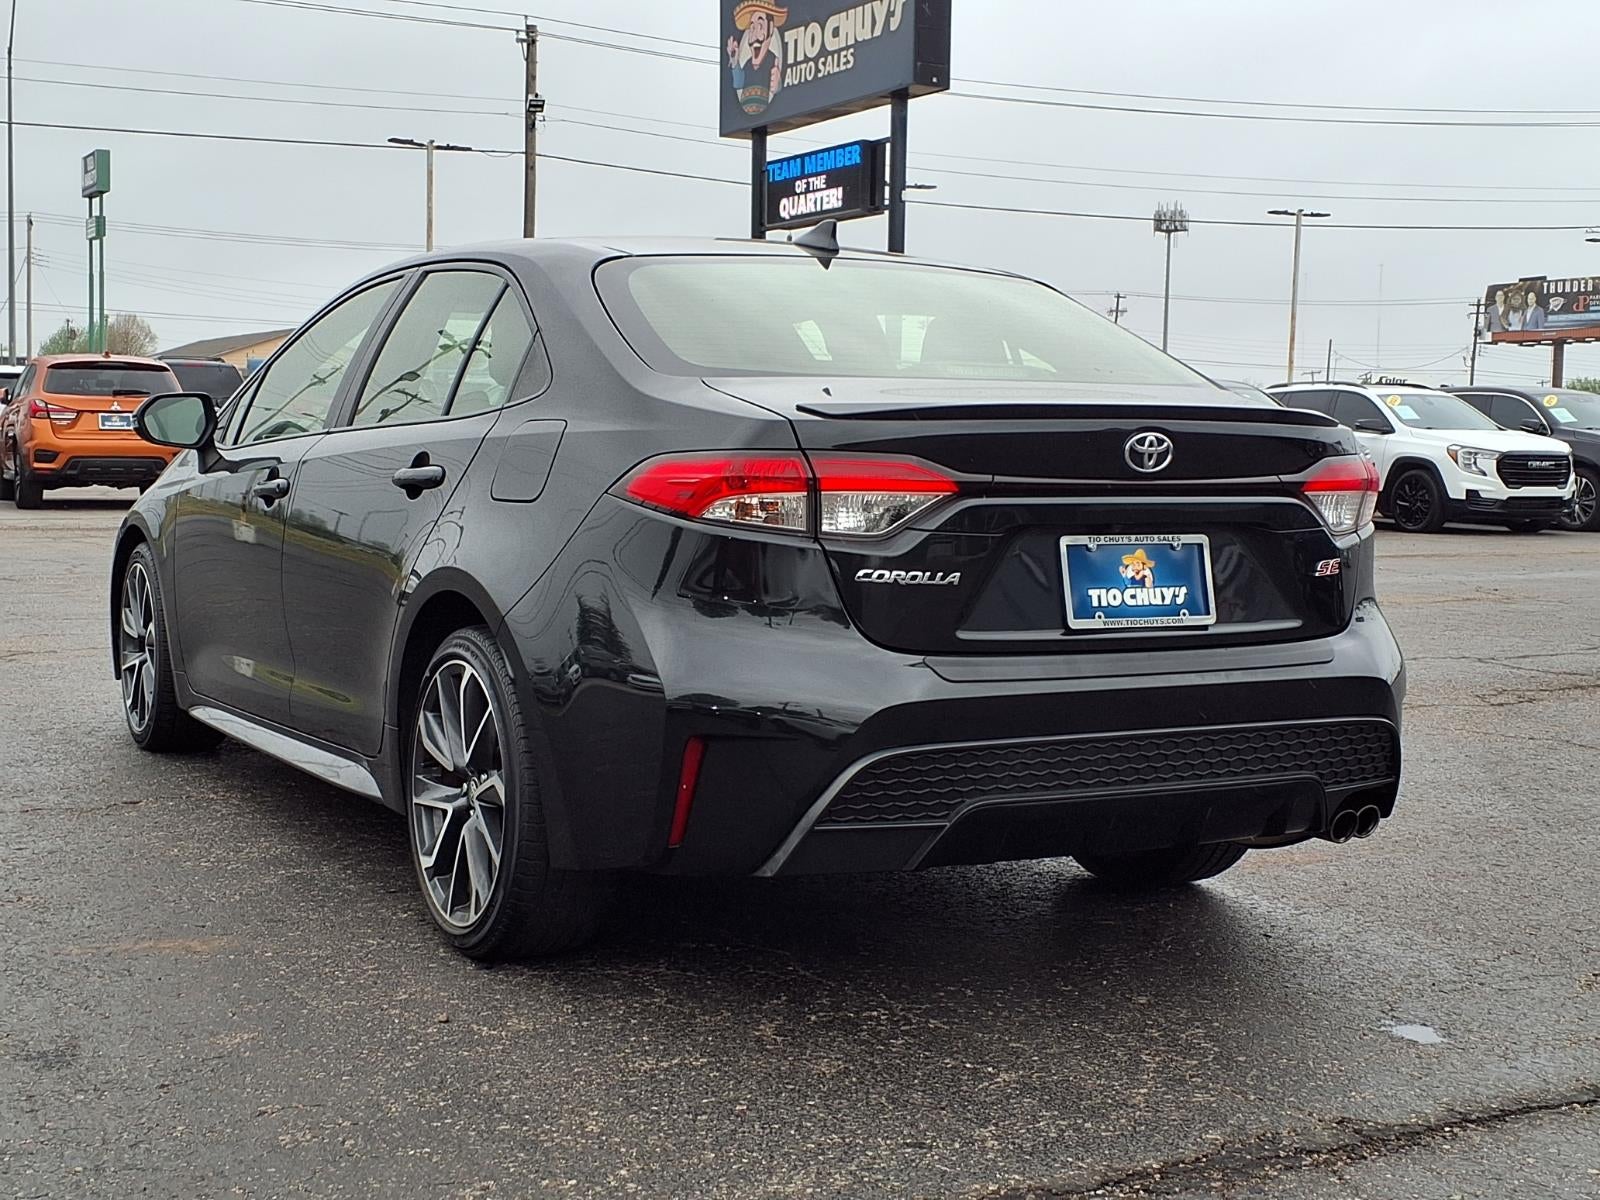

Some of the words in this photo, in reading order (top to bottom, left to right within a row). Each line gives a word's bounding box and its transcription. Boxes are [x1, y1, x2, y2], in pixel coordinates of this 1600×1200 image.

[784, 22, 822, 64] TIO
[784, 61, 815, 87] AUTO
[818, 48, 854, 78] SALES
[767, 158, 801, 182] TEAM
[804, 144, 861, 174] MEMBER
[795, 178, 808, 194] OF
[808, 175, 827, 191] THE
[779, 186, 843, 220] QUARTER!
[1542, 279, 1593, 294] THUNDER
[1527, 460, 1556, 469] GMC
[1087, 536, 1102, 544] TIO
[1103, 535, 1132, 543] CHUY'S
[1134, 535, 1155, 543] AUTO
[1157, 535, 1182, 543] SALES
[1315, 557, 1341, 577] SE
[854, 569, 961, 585] COROLLA
[1087, 588, 1122, 607] TIO
[1123, 586, 1188, 606] CHUY'S
[1102, 617, 1184, 627] WWW.TIOCHUYS.COM
